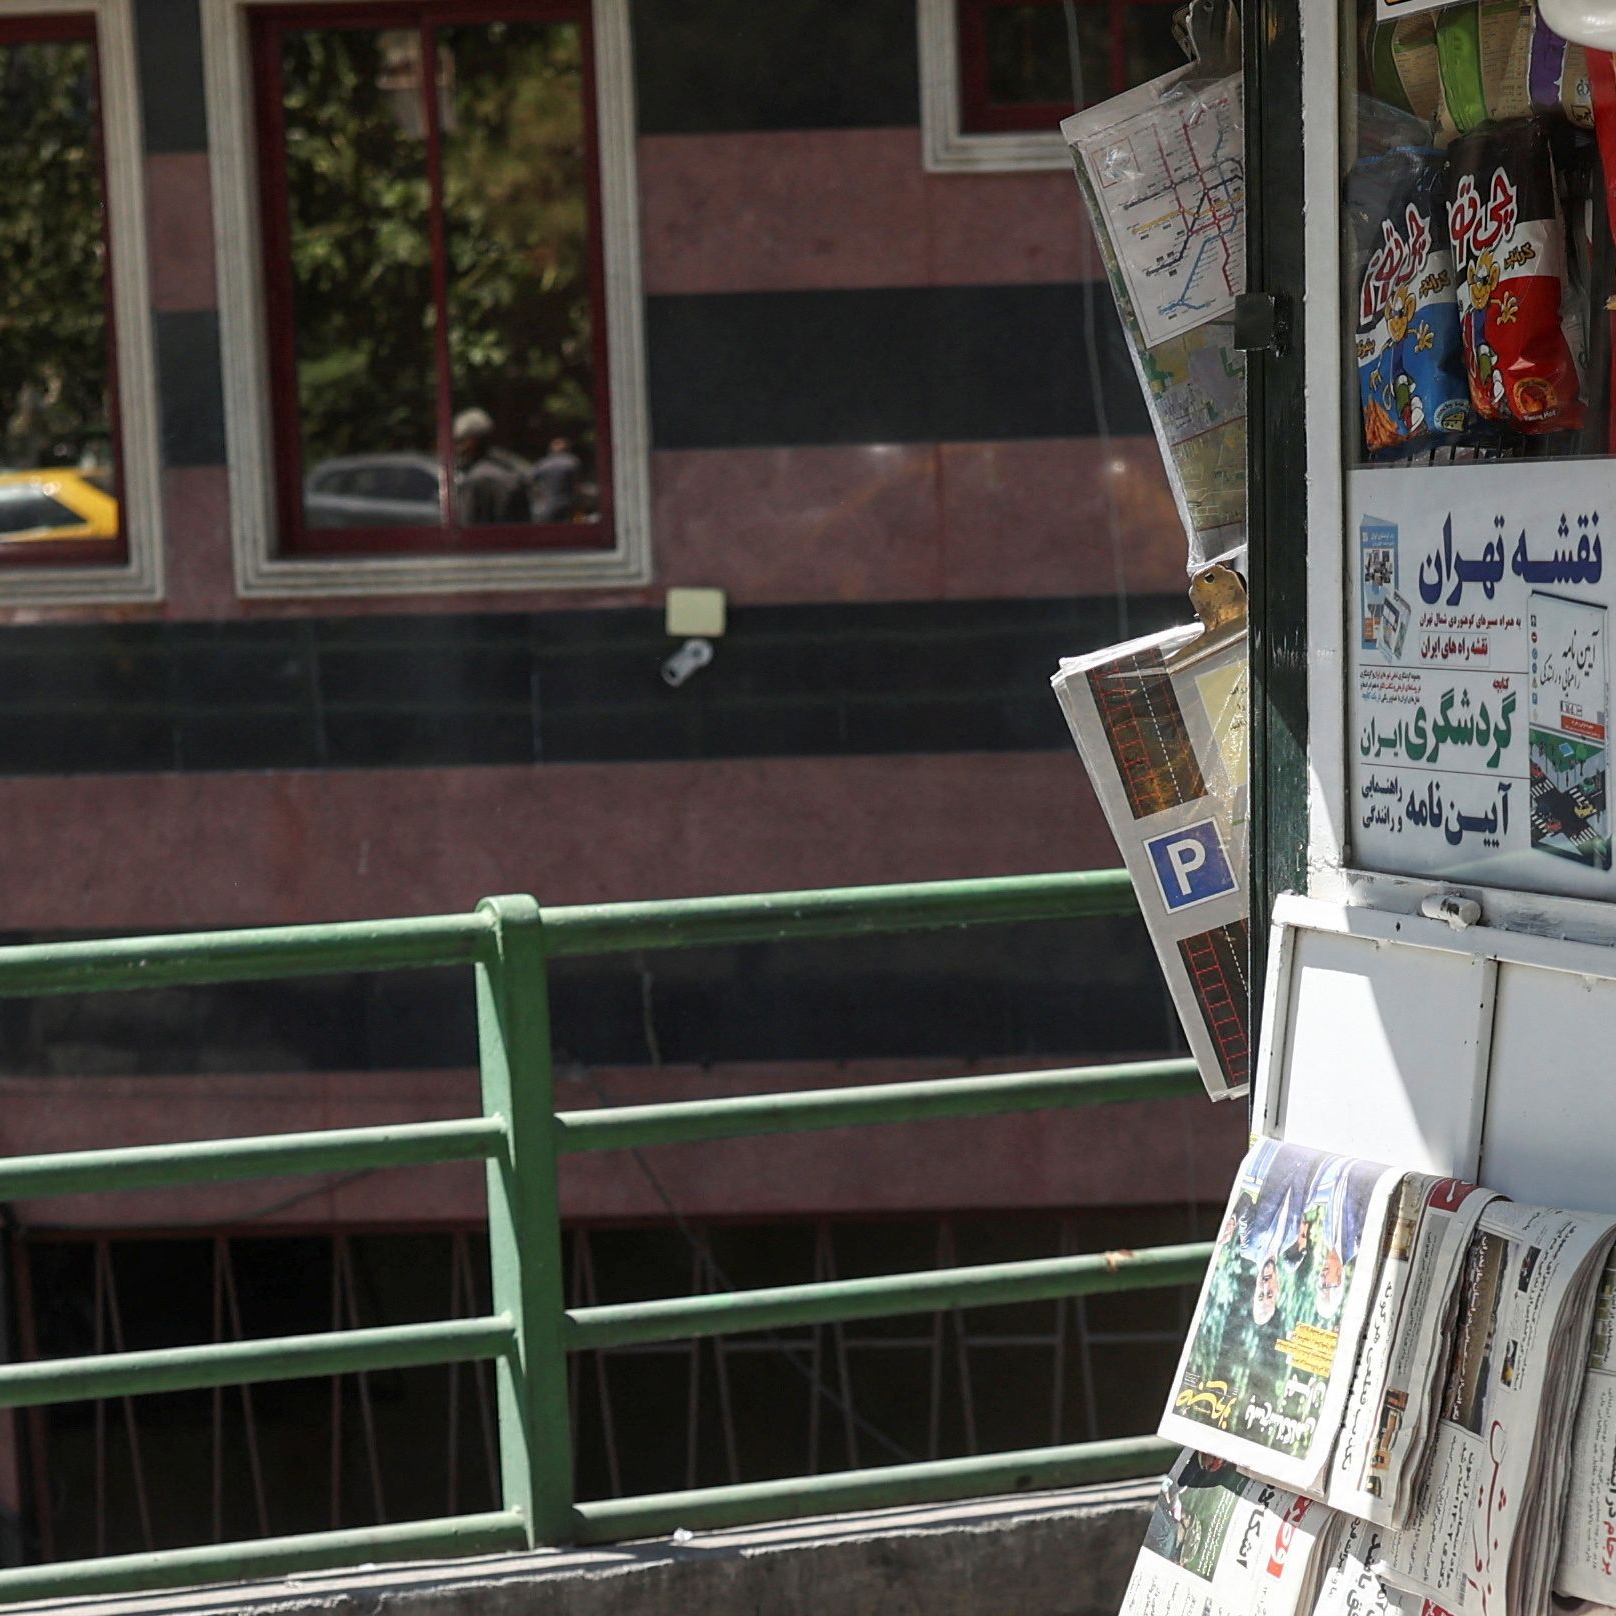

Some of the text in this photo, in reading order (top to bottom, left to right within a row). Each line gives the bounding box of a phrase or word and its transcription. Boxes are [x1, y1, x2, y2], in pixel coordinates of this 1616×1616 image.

[1419, 511, 1601, 606] نقشه تهران
[1419, 612, 1433, 627] تهران
[1421, 636, 1440, 658] ایران
[1458, 639, 1470, 660] راه
[1471, 638, 1488, 655] نقشه
[1361, 716, 1401, 757] ایران
[1405, 688, 1516, 768] گردشگری
[1361, 774, 1402, 800] راهنمایی
[1363, 805, 1396, 832] رانندگی
[1406, 780, 1512, 848] آیین نامه
[1166, 838, 1206, 896] P
[1604, 1497, 1616, 1517] در
[1356, 1532, 1381, 1589] باشد
